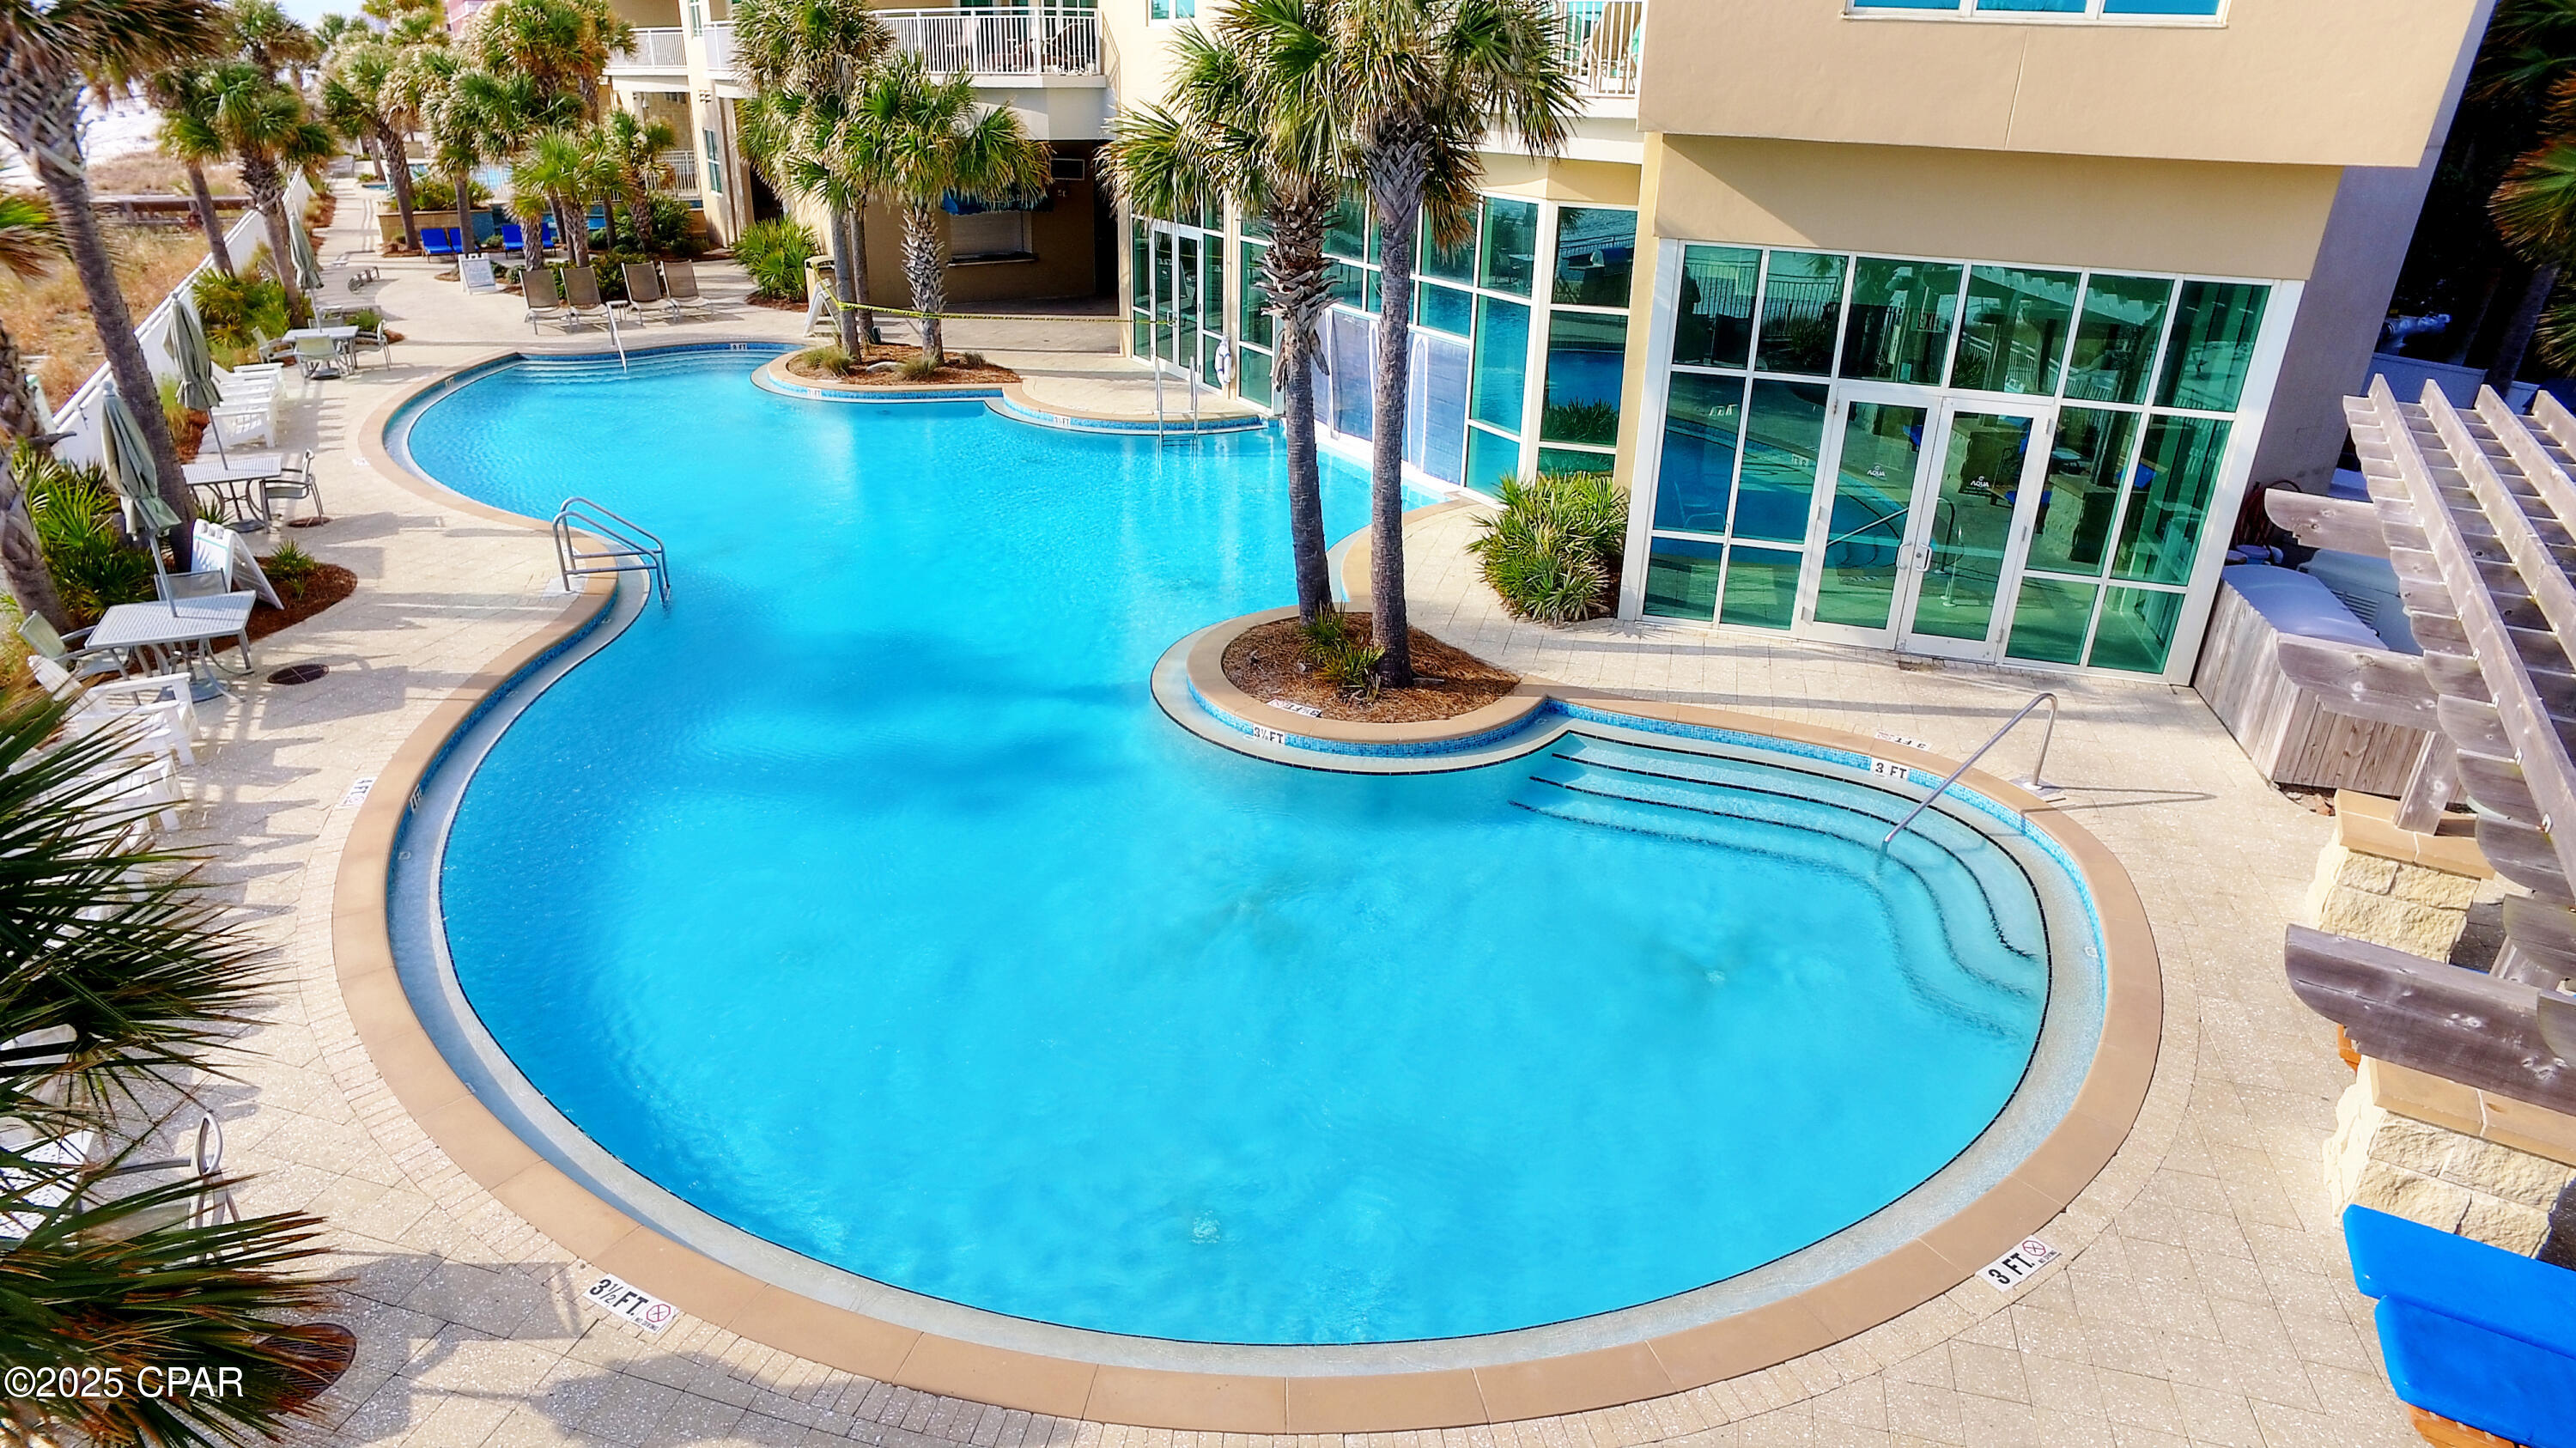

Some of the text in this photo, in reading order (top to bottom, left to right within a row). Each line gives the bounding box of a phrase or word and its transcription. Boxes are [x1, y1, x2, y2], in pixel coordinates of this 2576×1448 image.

[1917, 312, 1941, 331] EXIT
[1269, 732, 1284, 744] FT
[1875, 763, 1907, 779] 3 FT
[1988, 1252, 2035, 1285] 3 FT.
[612, 1291, 648, 1317] FT.
